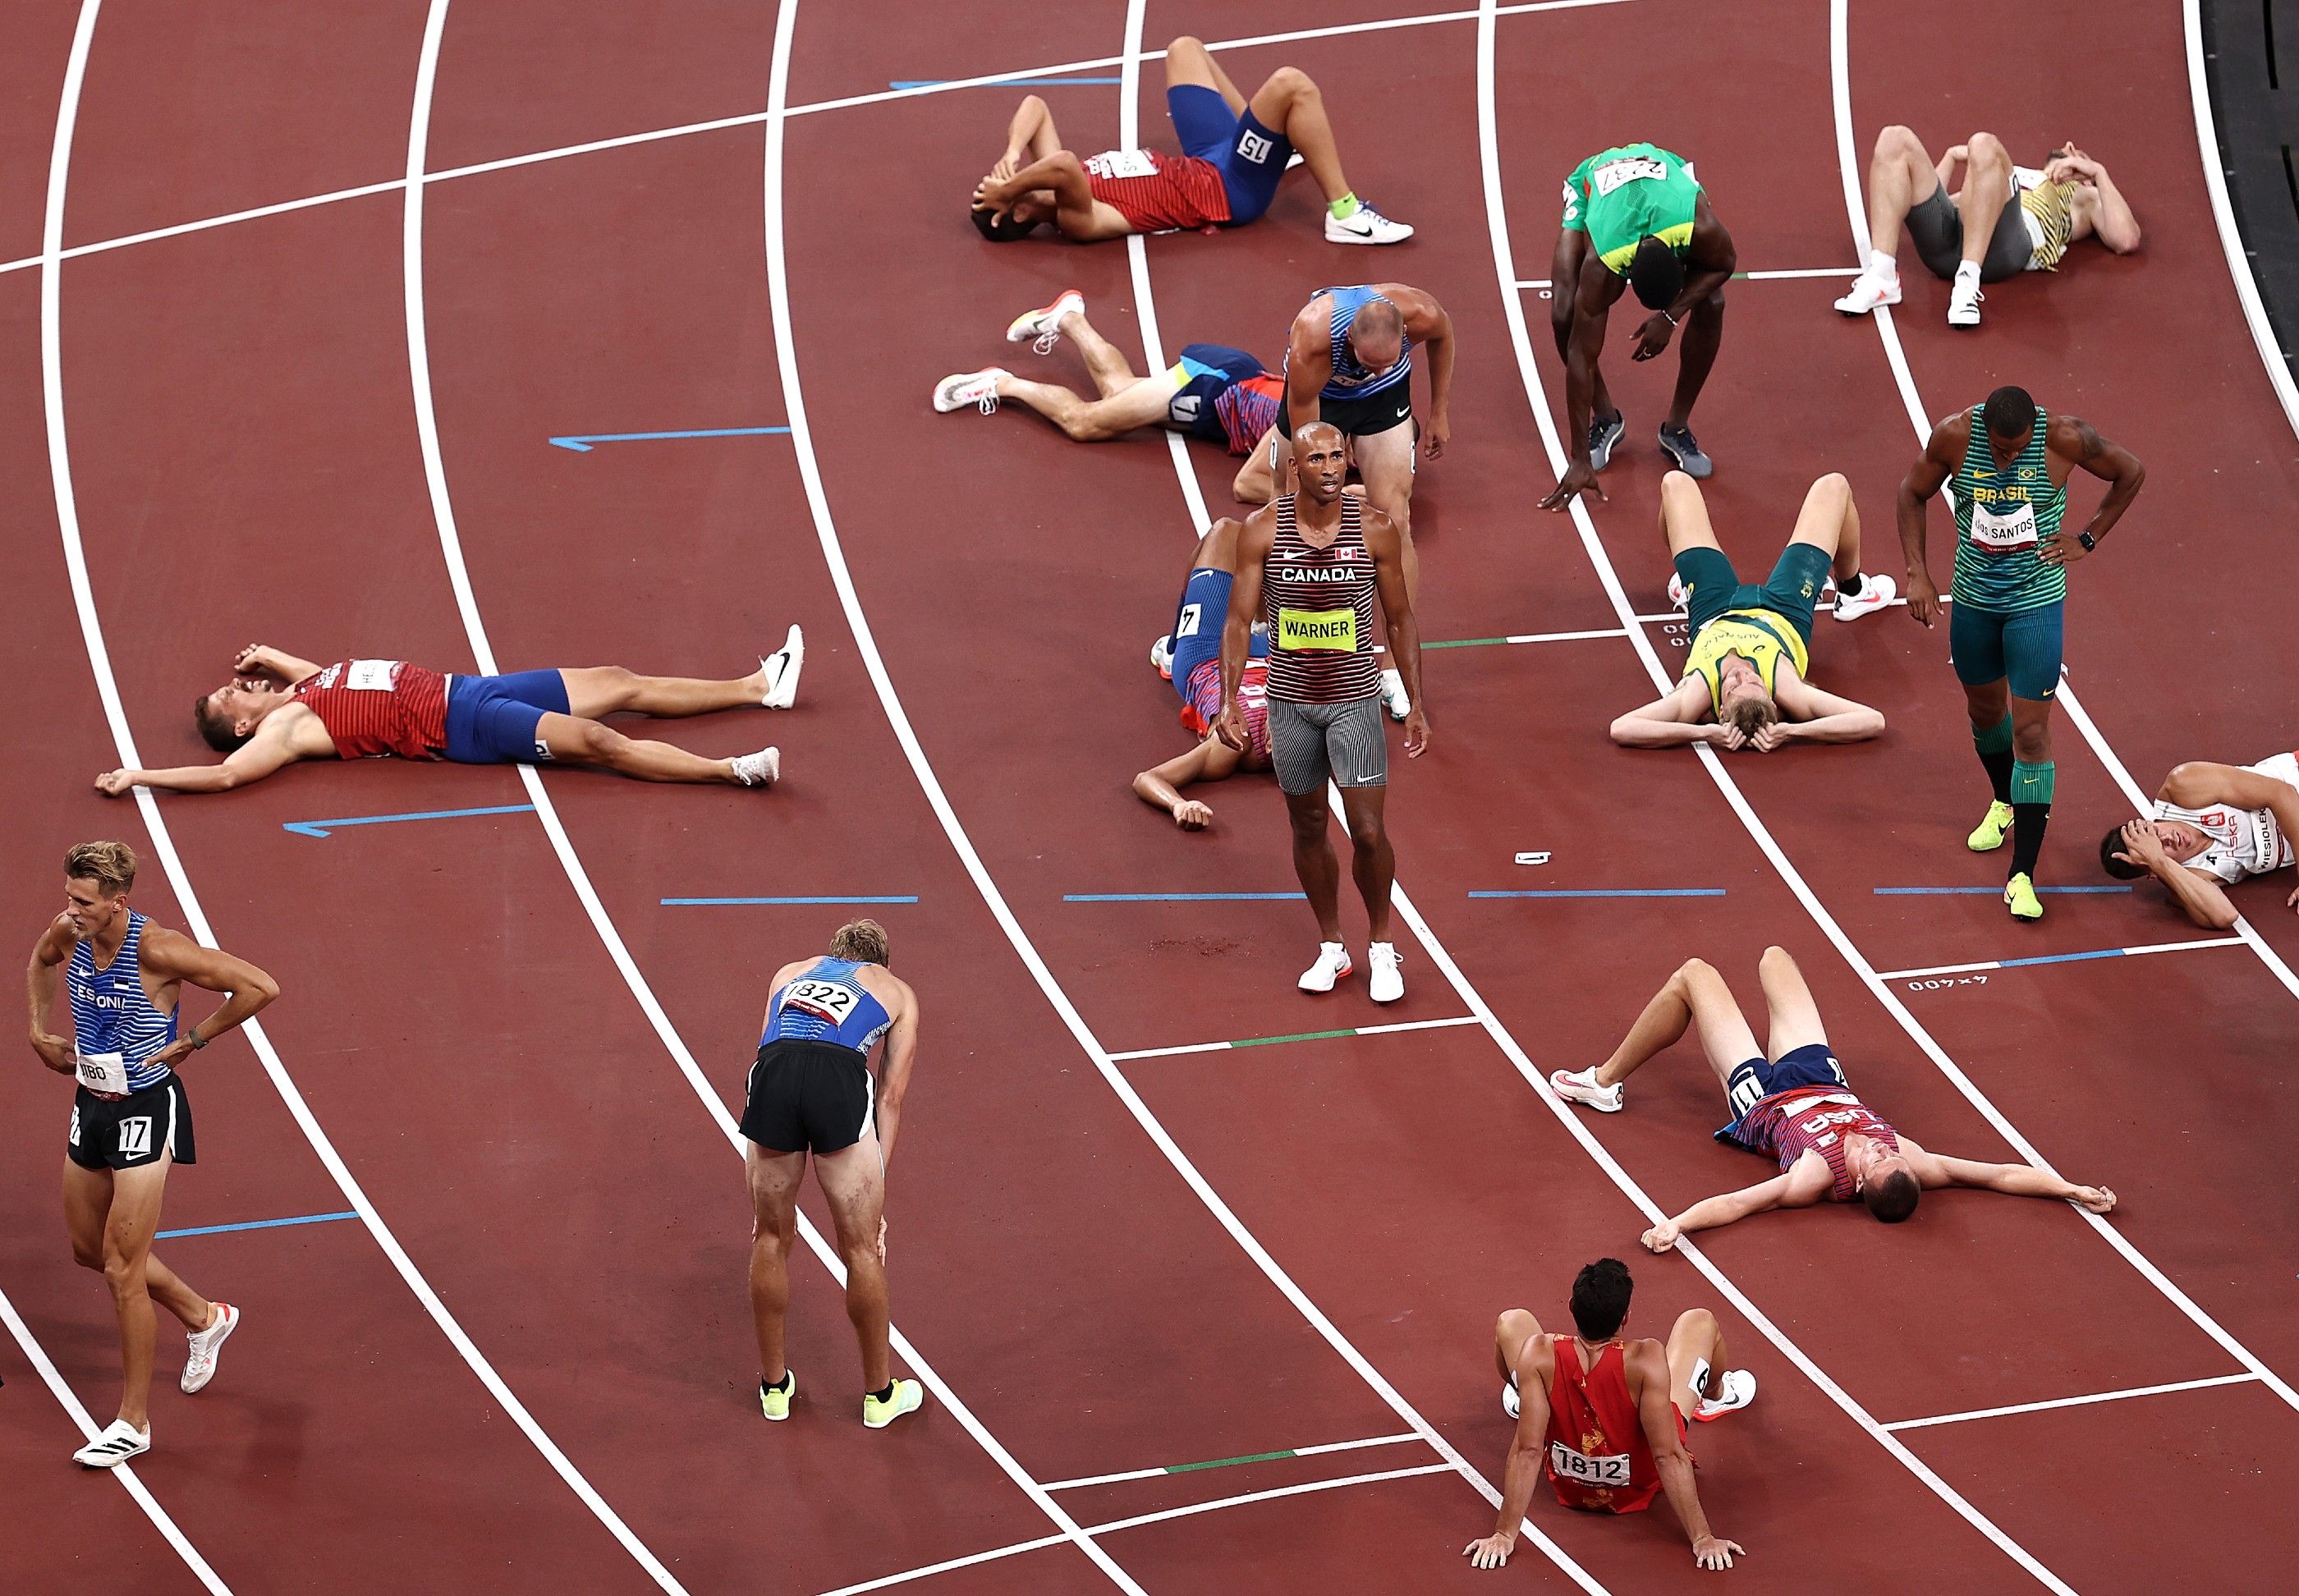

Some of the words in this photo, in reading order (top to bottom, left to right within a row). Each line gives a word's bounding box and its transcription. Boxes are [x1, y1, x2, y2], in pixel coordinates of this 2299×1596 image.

[1242, 136, 1264, 160] 15
[1973, 486, 2033, 505] BRASIL
[1991, 518, 2033, 539] SANTOS
[1282, 567, 1356, 582] CANADA
[1285, 621, 1349, 638] WARNER
[77, 984, 126, 1010] ESONI
[787, 984, 850, 1012] 1822
[1736, 1082, 1762, 1111] 11
[1801, 1108, 1876, 1134] USA
[124, 1120, 147, 1149] 17
[1558, 1449, 1622, 1479] 1812
